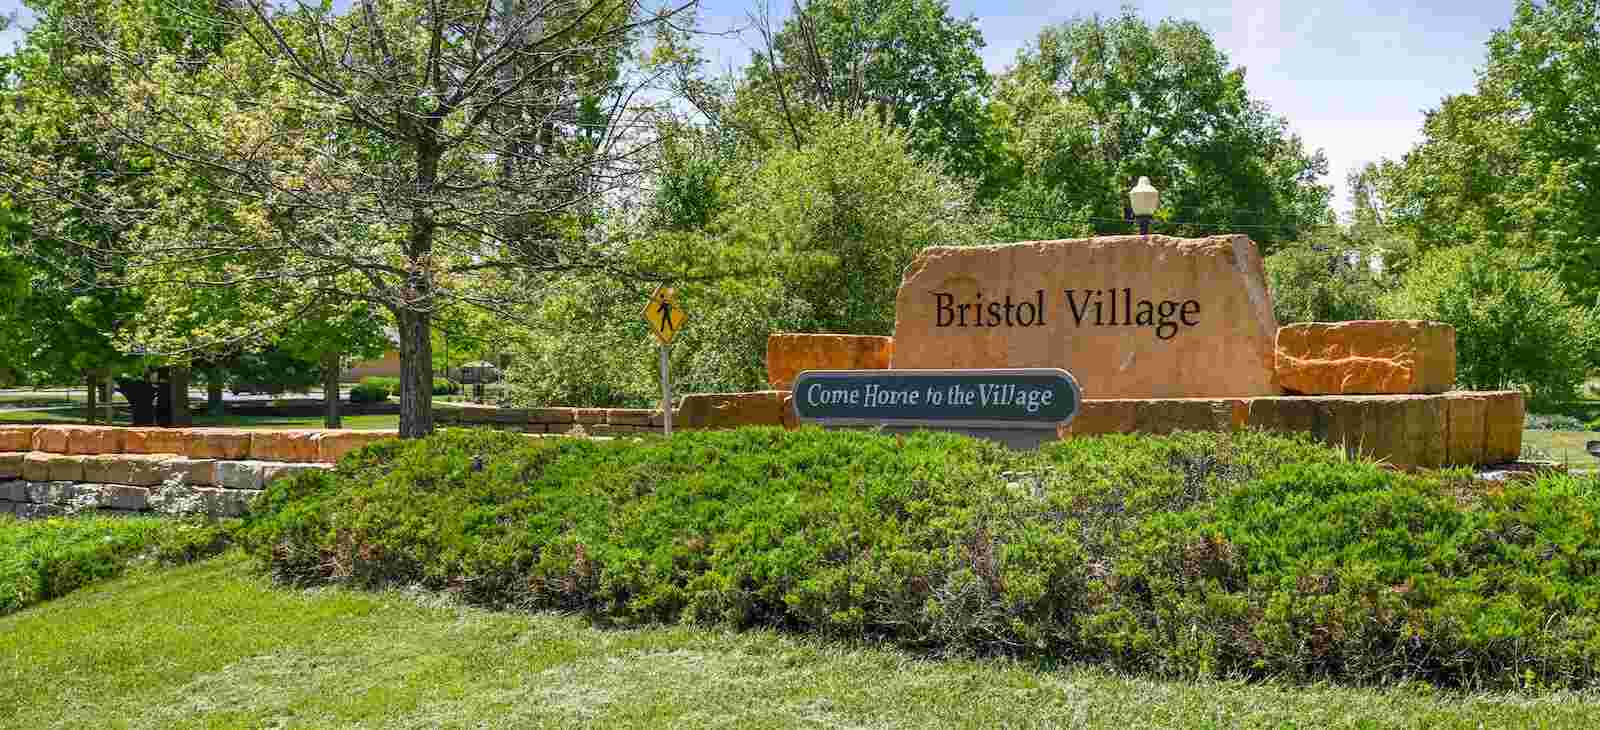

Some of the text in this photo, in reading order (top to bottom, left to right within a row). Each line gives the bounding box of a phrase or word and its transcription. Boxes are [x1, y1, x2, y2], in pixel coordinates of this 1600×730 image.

[929, 288, 1200, 340] Bristol Village
[807, 383, 1052, 411] Come Home to the Village
